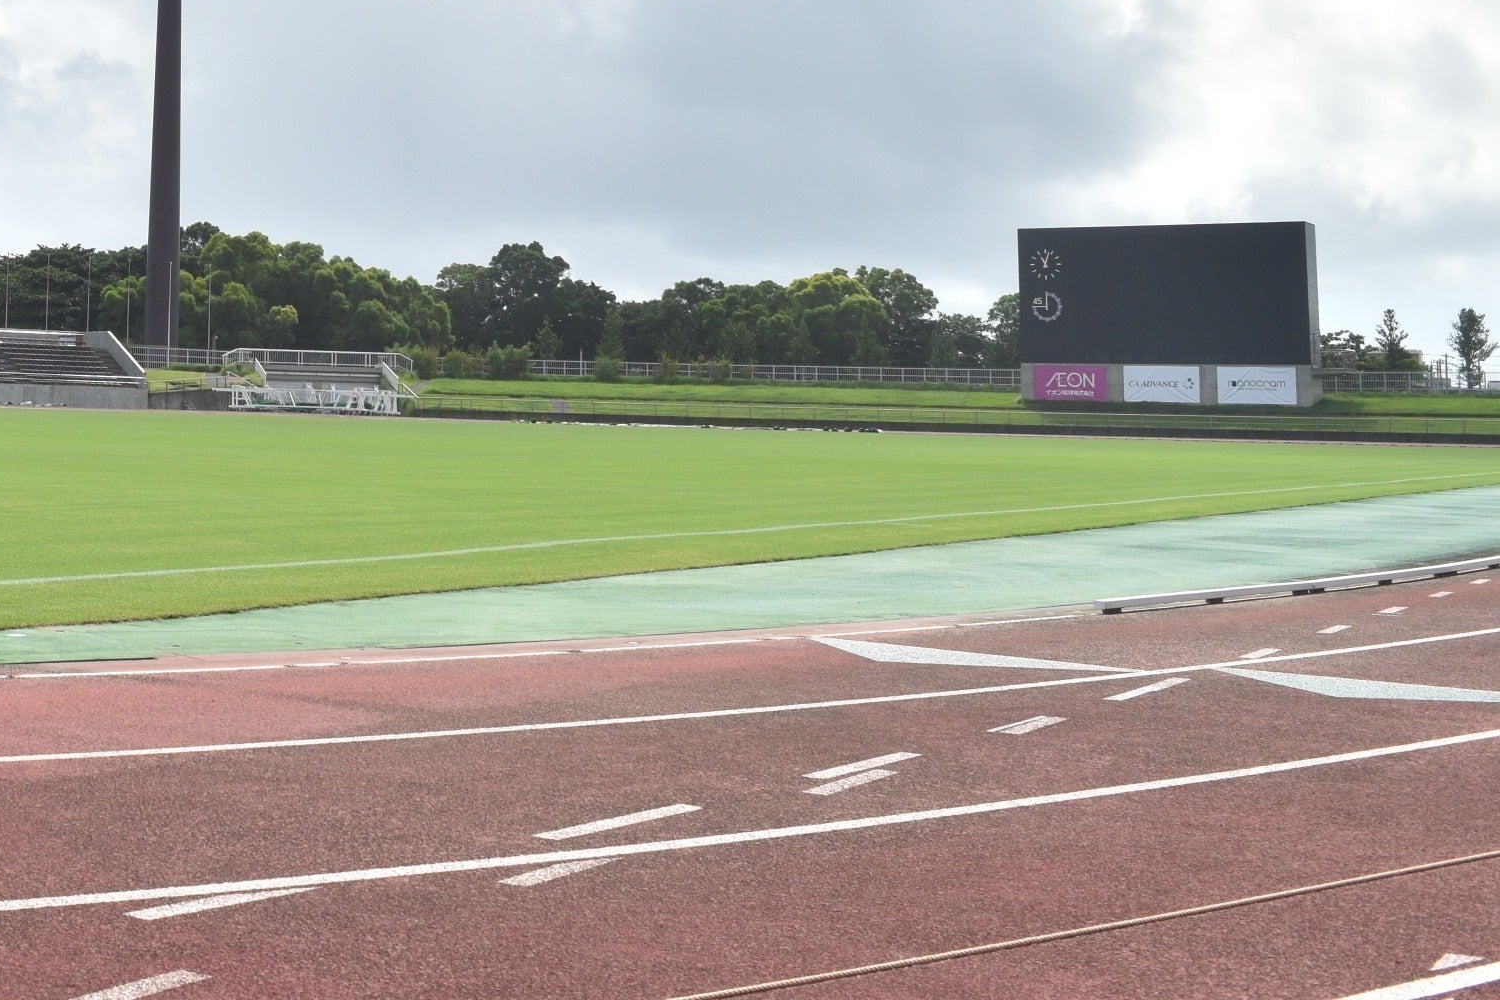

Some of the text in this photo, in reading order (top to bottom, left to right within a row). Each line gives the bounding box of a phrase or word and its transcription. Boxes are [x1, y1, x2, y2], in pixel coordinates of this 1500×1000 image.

[1033, 297, 1043, 305] 45
[1128, 380, 1180, 388] CA ADVANCE
